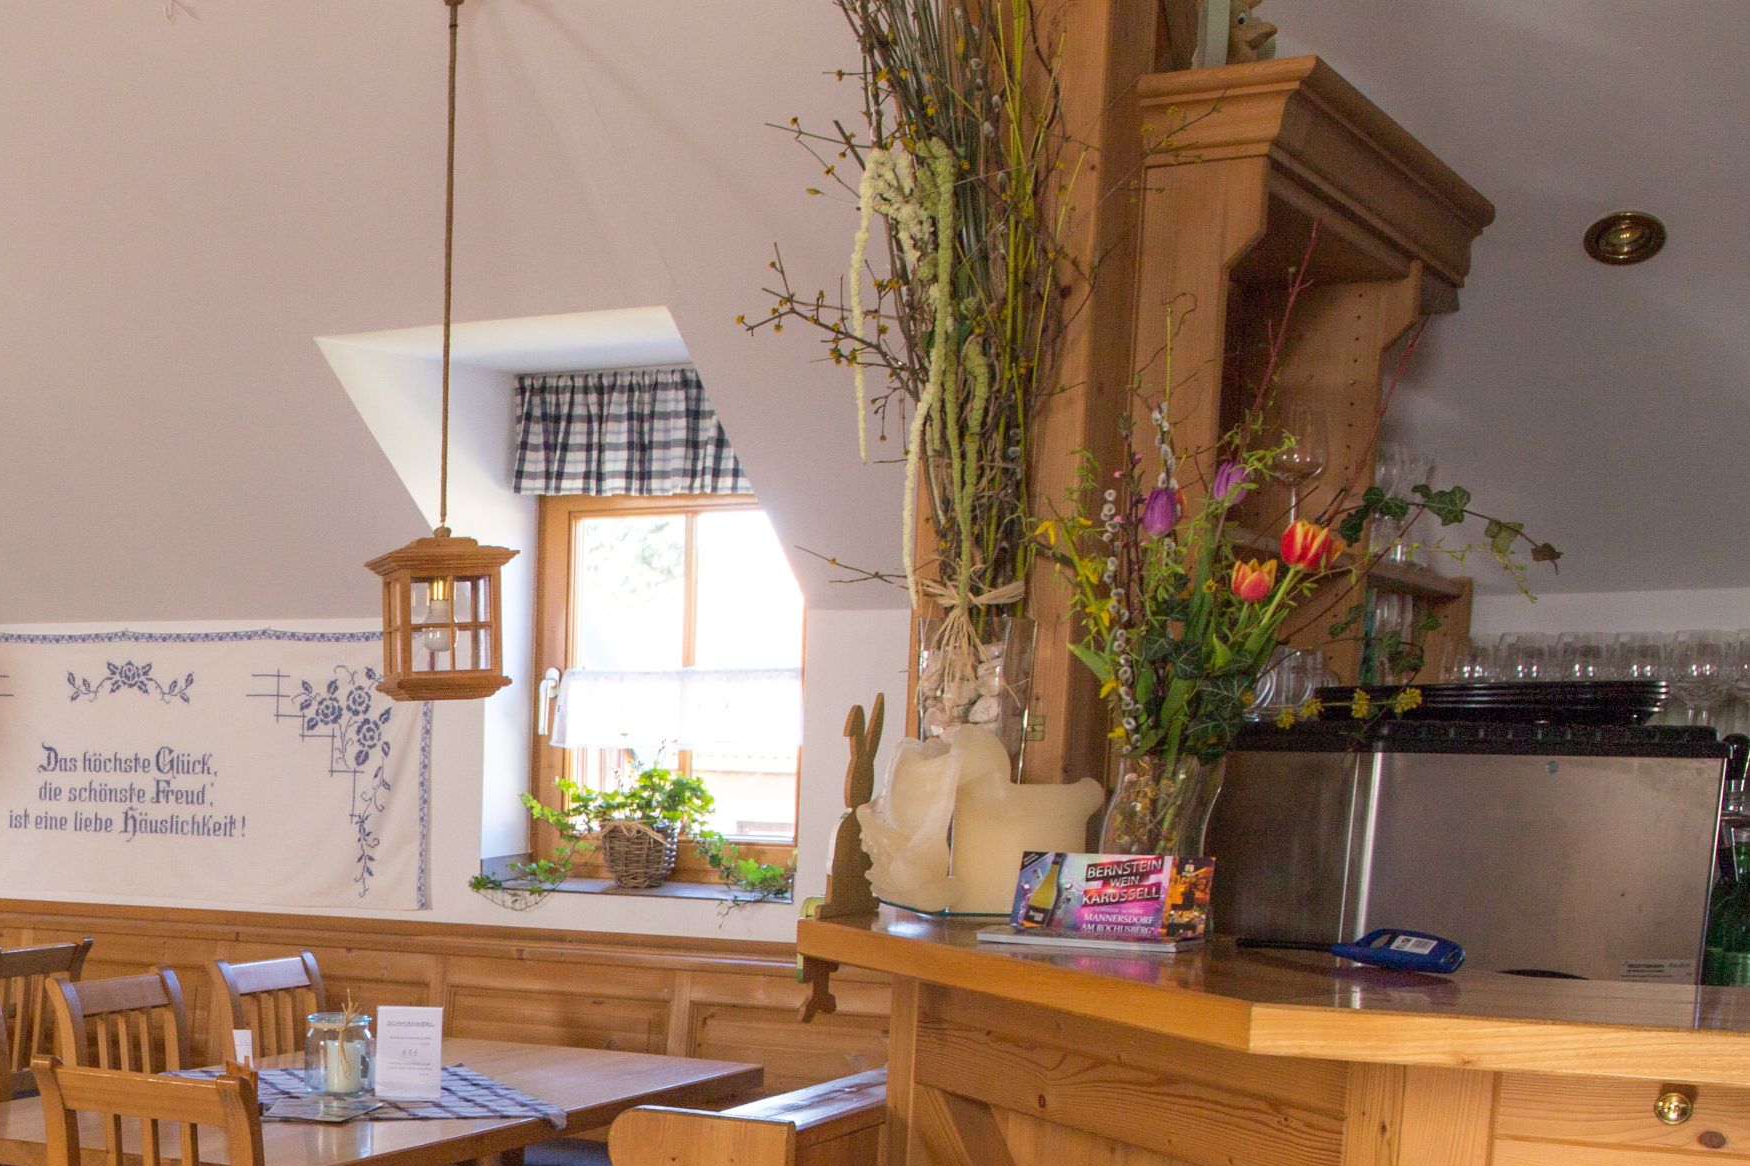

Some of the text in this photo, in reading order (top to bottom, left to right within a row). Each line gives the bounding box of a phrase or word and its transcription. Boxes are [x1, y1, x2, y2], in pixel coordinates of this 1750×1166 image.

[37, 741, 218, 779] Das höchste Glück,
[38, 780, 62, 801] die
[68, 779, 146, 803] schönste
[9, 808, 30, 829] ist
[34, 811, 67, 831] eine
[73, 810, 113, 832] liebe
[1087, 859, 1162, 879] BERNSTEIN
[1110, 875, 1140, 888] WEIN
[1082, 886, 1162, 905] KARUSSELL
[1081, 923, 1095, 933] AM
[1083, 912, 1154, 925] MANNERSDORF
